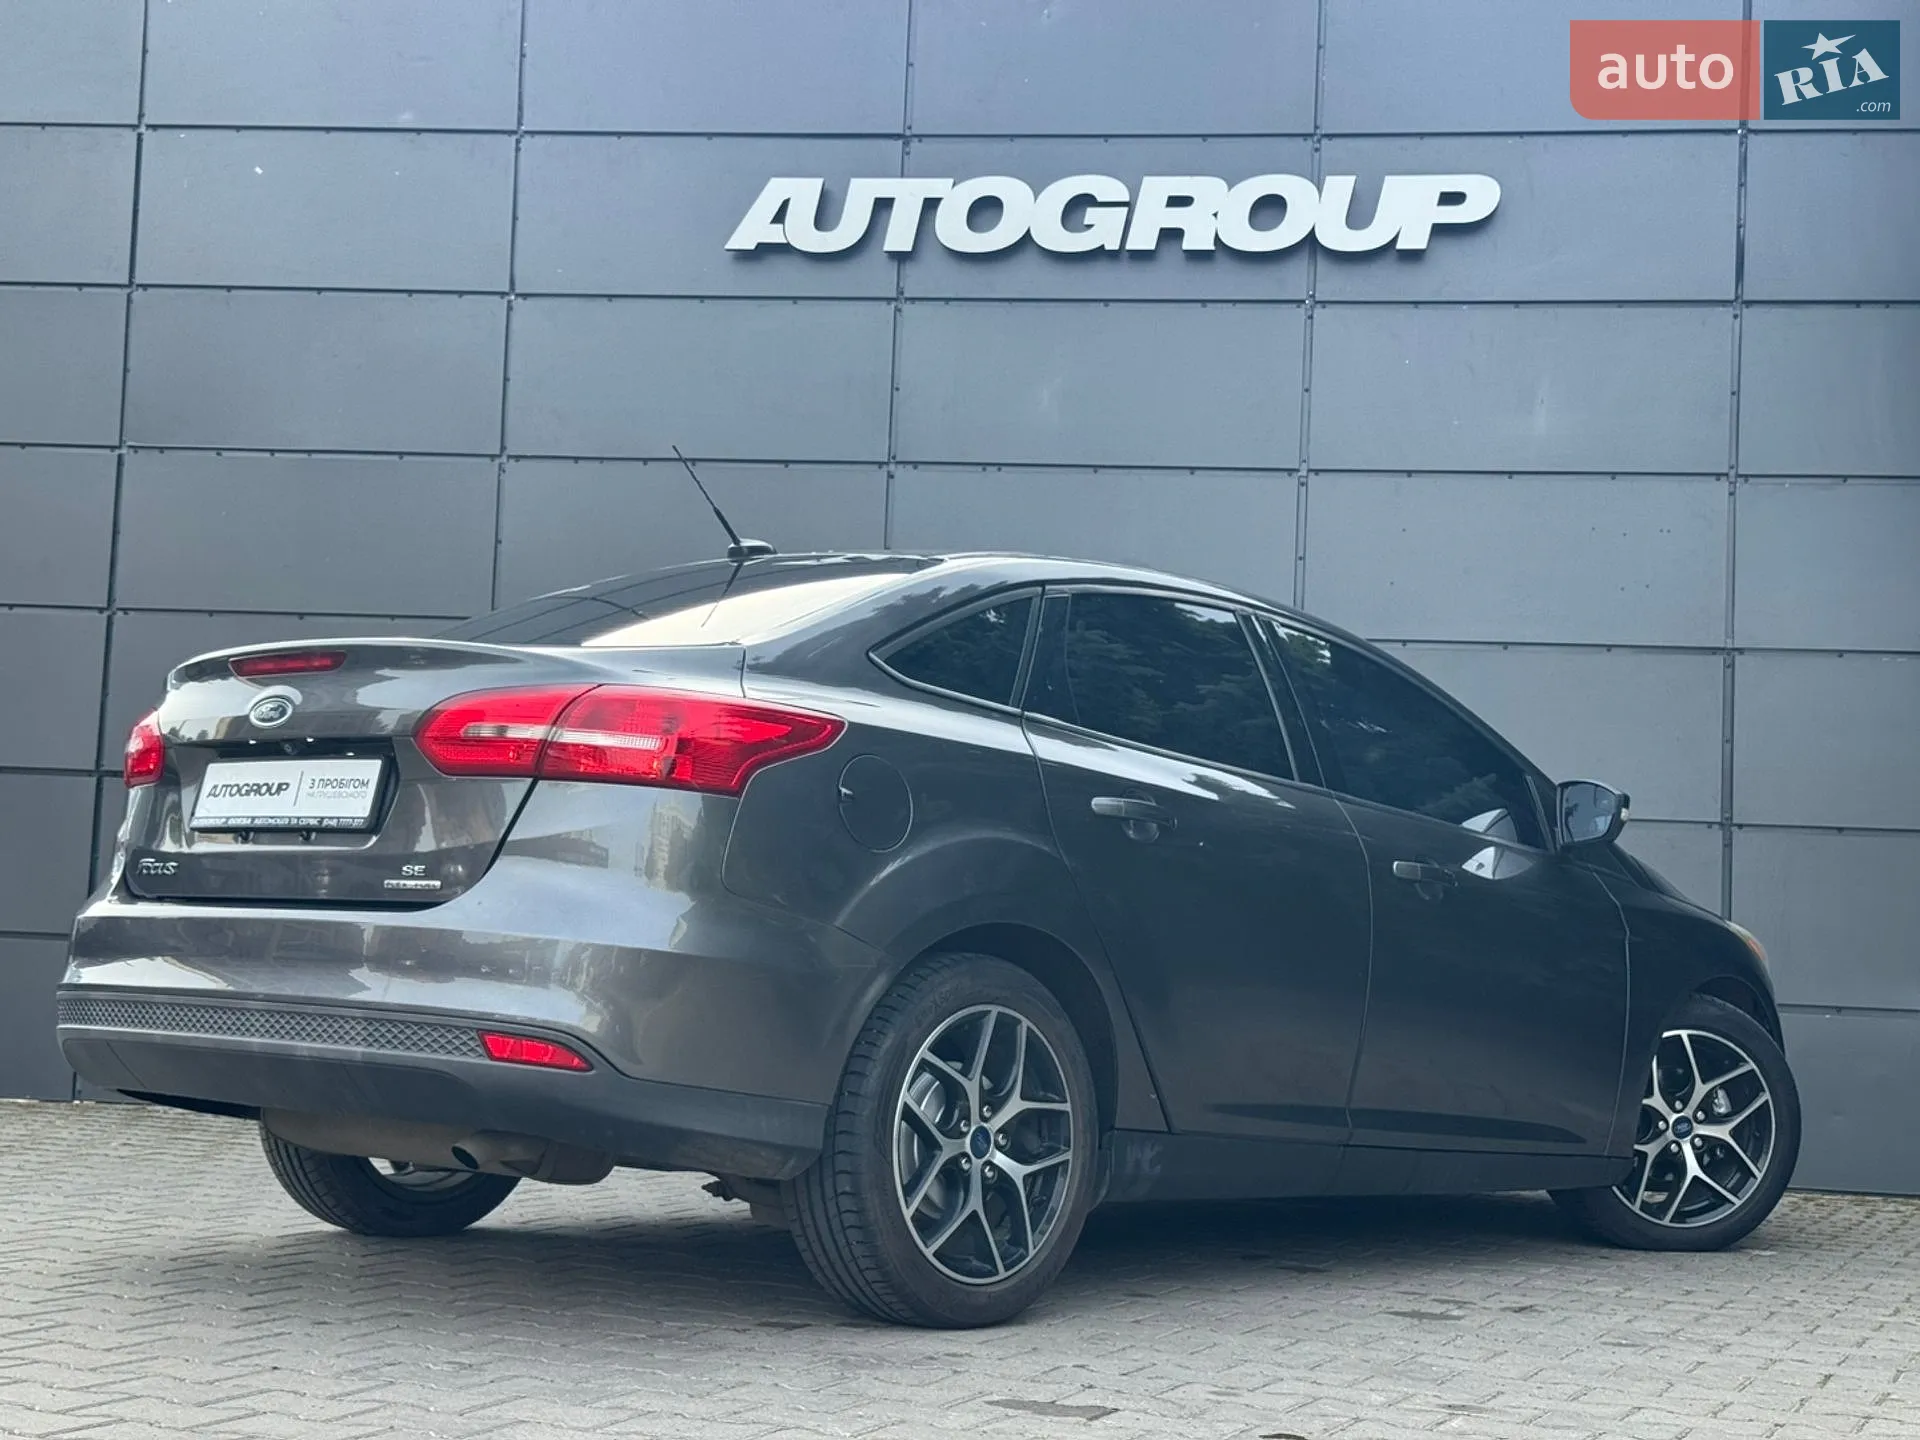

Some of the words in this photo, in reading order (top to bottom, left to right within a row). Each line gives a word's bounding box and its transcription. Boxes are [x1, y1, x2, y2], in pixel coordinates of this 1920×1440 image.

[724, 173, 1502, 255] AUTOGROUP
[206, 782, 290, 799] AUTOGROUP
[316, 778, 370, 790] ПРОБІГОМ
[401, 865, 426, 876] SE
